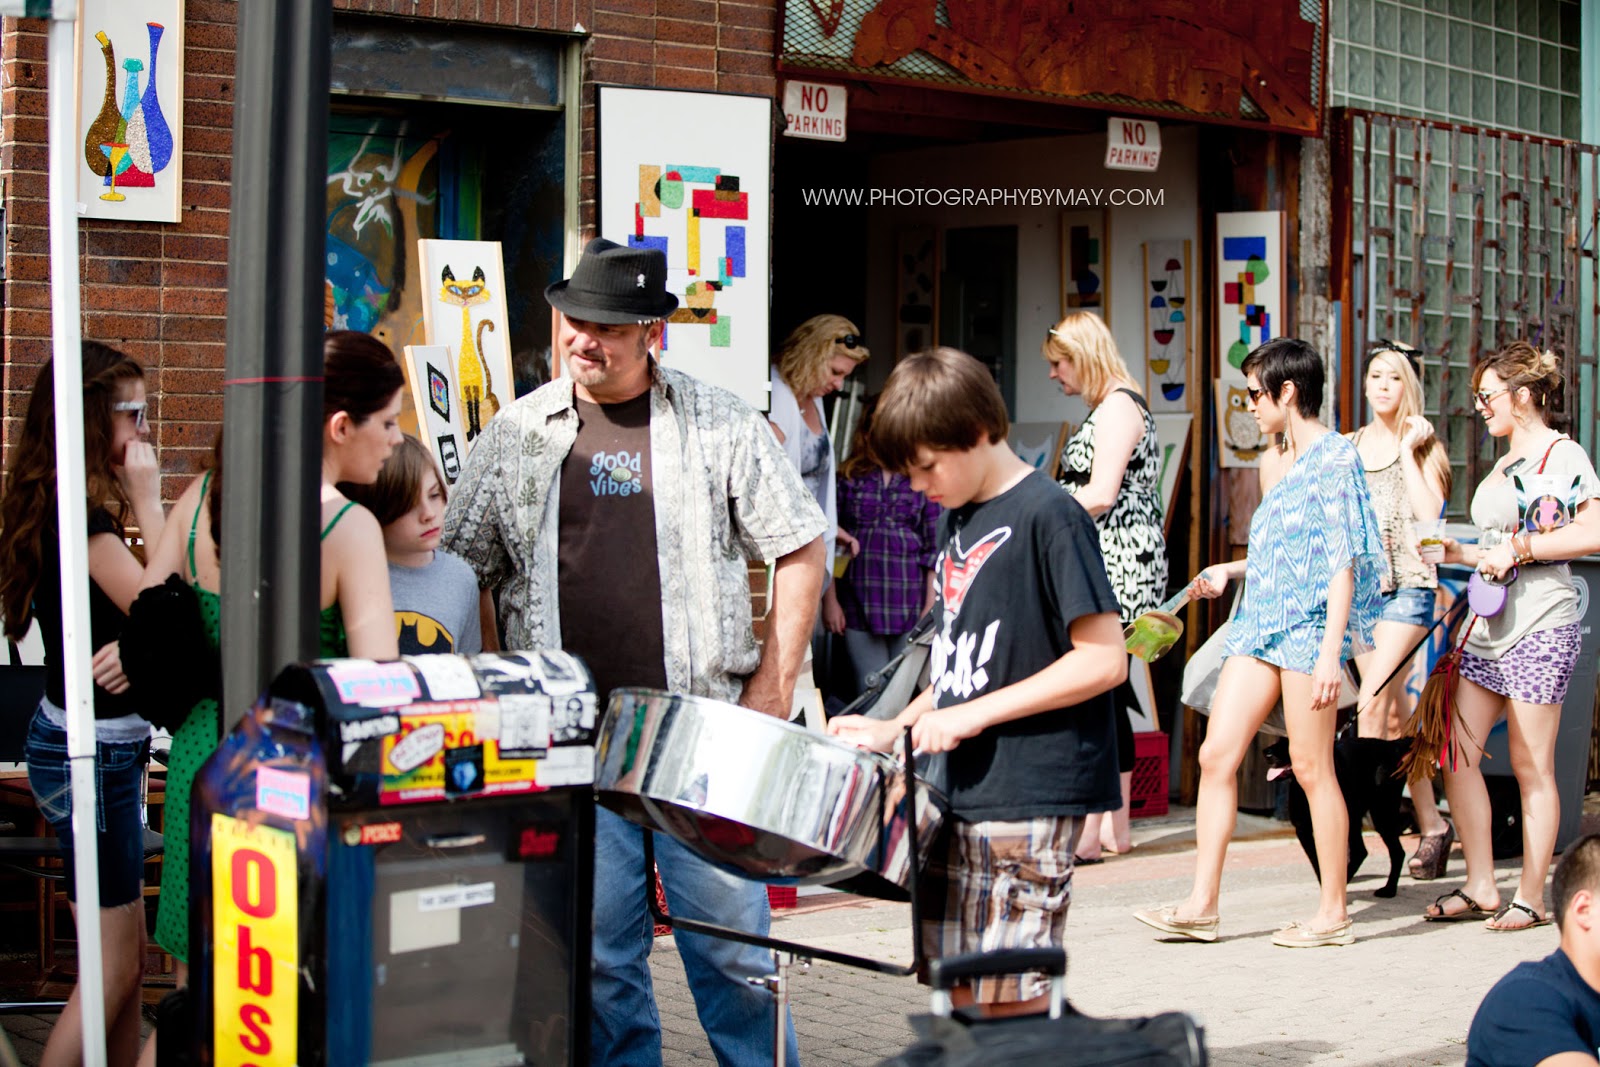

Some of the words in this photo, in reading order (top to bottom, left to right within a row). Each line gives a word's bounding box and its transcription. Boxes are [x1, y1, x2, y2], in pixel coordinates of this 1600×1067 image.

[800, 85, 829, 113] NO
[785, 113, 842, 137] PARKING
[1121, 121, 1146, 146] NO
[1108, 147, 1157, 168] PARKING
[230, 847, 277, 1067] Obs
